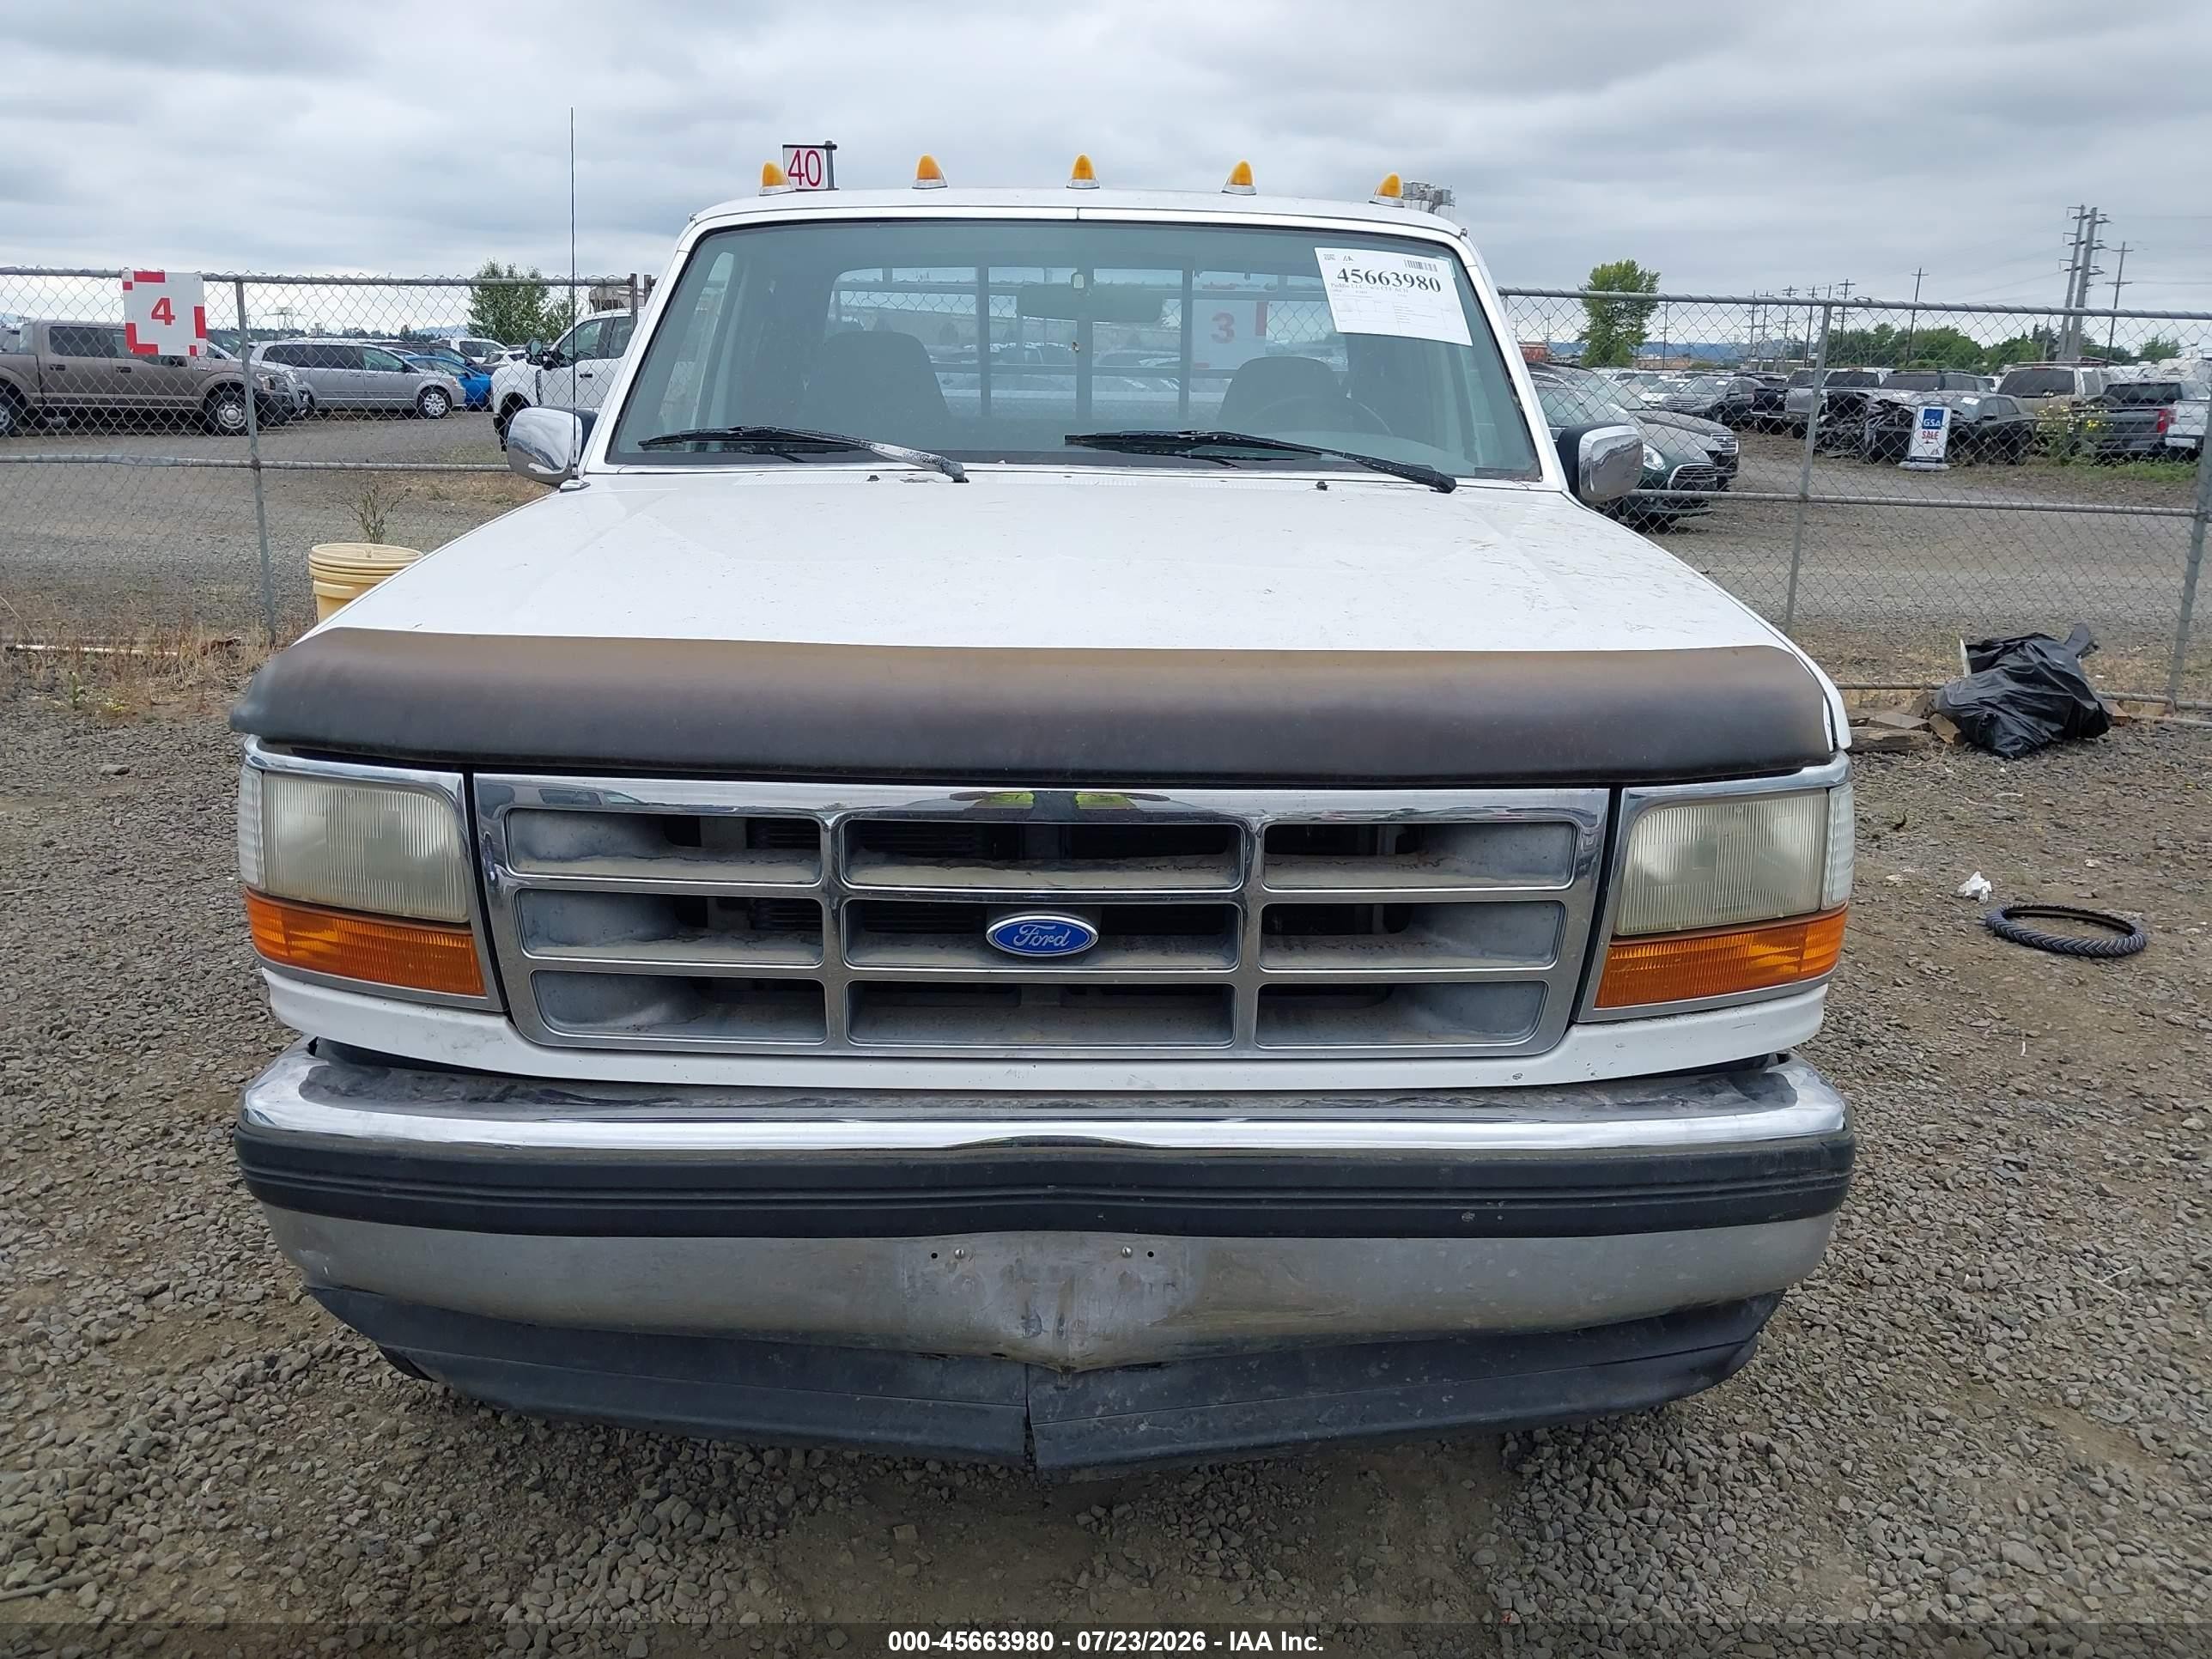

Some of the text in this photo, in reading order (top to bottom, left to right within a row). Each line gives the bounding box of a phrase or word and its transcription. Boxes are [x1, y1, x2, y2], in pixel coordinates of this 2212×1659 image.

[787, 149, 822, 187] 40
[1336, 267, 1442, 293] 45663980
[150, 297, 176, 326] 4
[1211, 312, 1235, 344] 3
[1921, 430, 1940, 441] SALE
[1923, 418, 1942, 427] GSA
[1012, 923, 1072, 947] Ford
